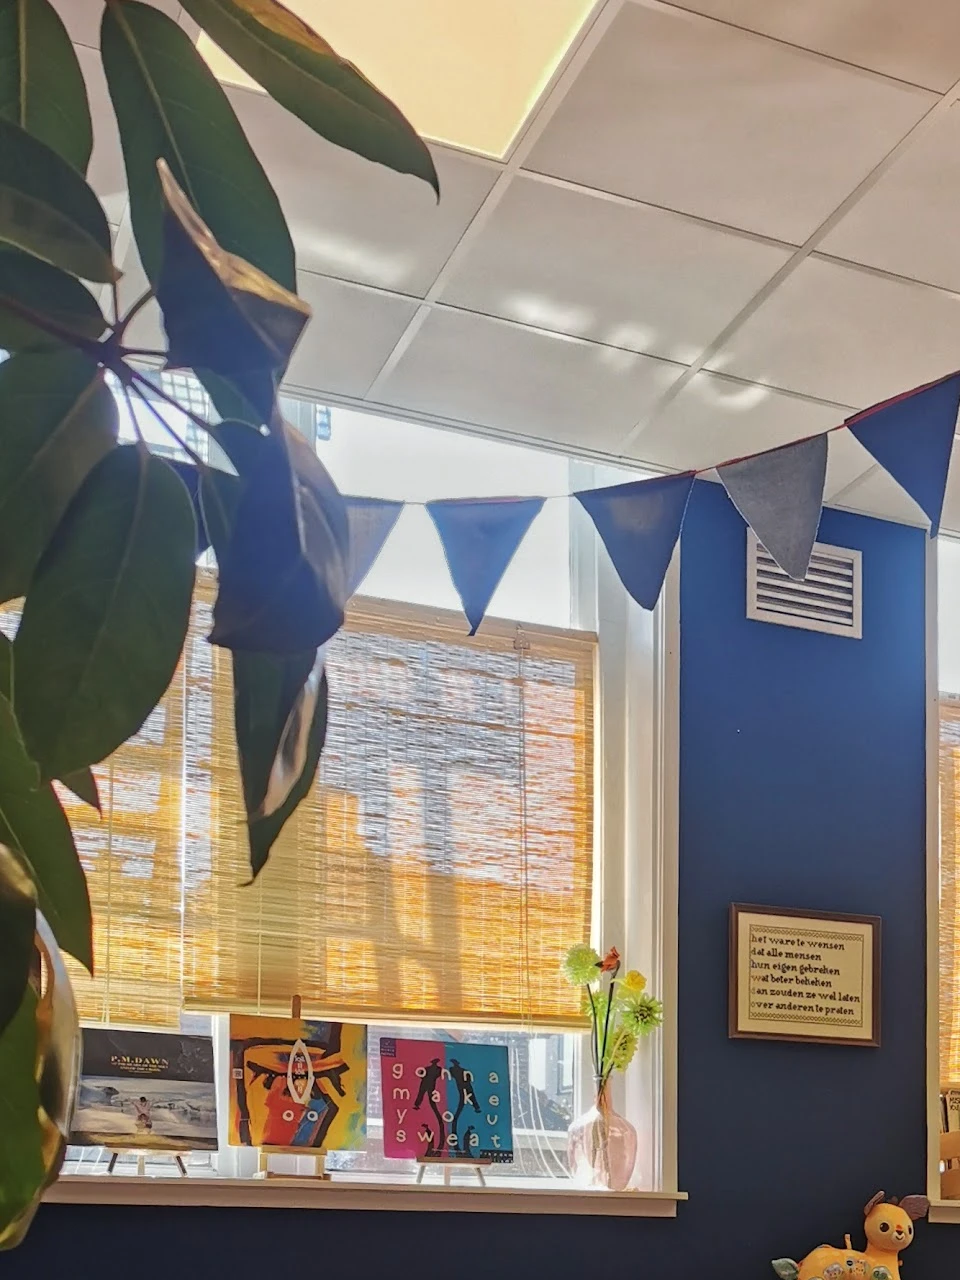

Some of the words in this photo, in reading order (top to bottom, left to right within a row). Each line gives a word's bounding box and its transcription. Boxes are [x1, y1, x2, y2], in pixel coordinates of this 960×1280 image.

[751, 934, 767, 944] het
[769, 936, 796, 946] ware
[797, 937, 805, 947] te
[807, 940, 845, 951] wensen
[751, 947, 765, 957] dat
[767, 948, 783, 957] alle
[785, 952, 822, 961] mensen
[751, 960, 770, 970] hun
[772, 961, 798, 974] eigen
[751, 973, 769, 983] wat
[771, 974, 794, 985] beter
[769, 988, 804, 998] zouden
[806, 992, 816, 1000] ze
[818, 991, 836, 1002] wel
[838, 992, 861, 1003] laten
[751, 1000, 774, 1010] over
[775, 1002, 814, 1013] anderen
[815, 1003, 823, 1014] te
[825, 1004, 854, 1016] praten
[392, 1063, 499, 1084] gonna
[393, 1088, 500, 1107] make
[397, 1108, 498, 1126] you
[396, 1129, 501, 1149] sweat
